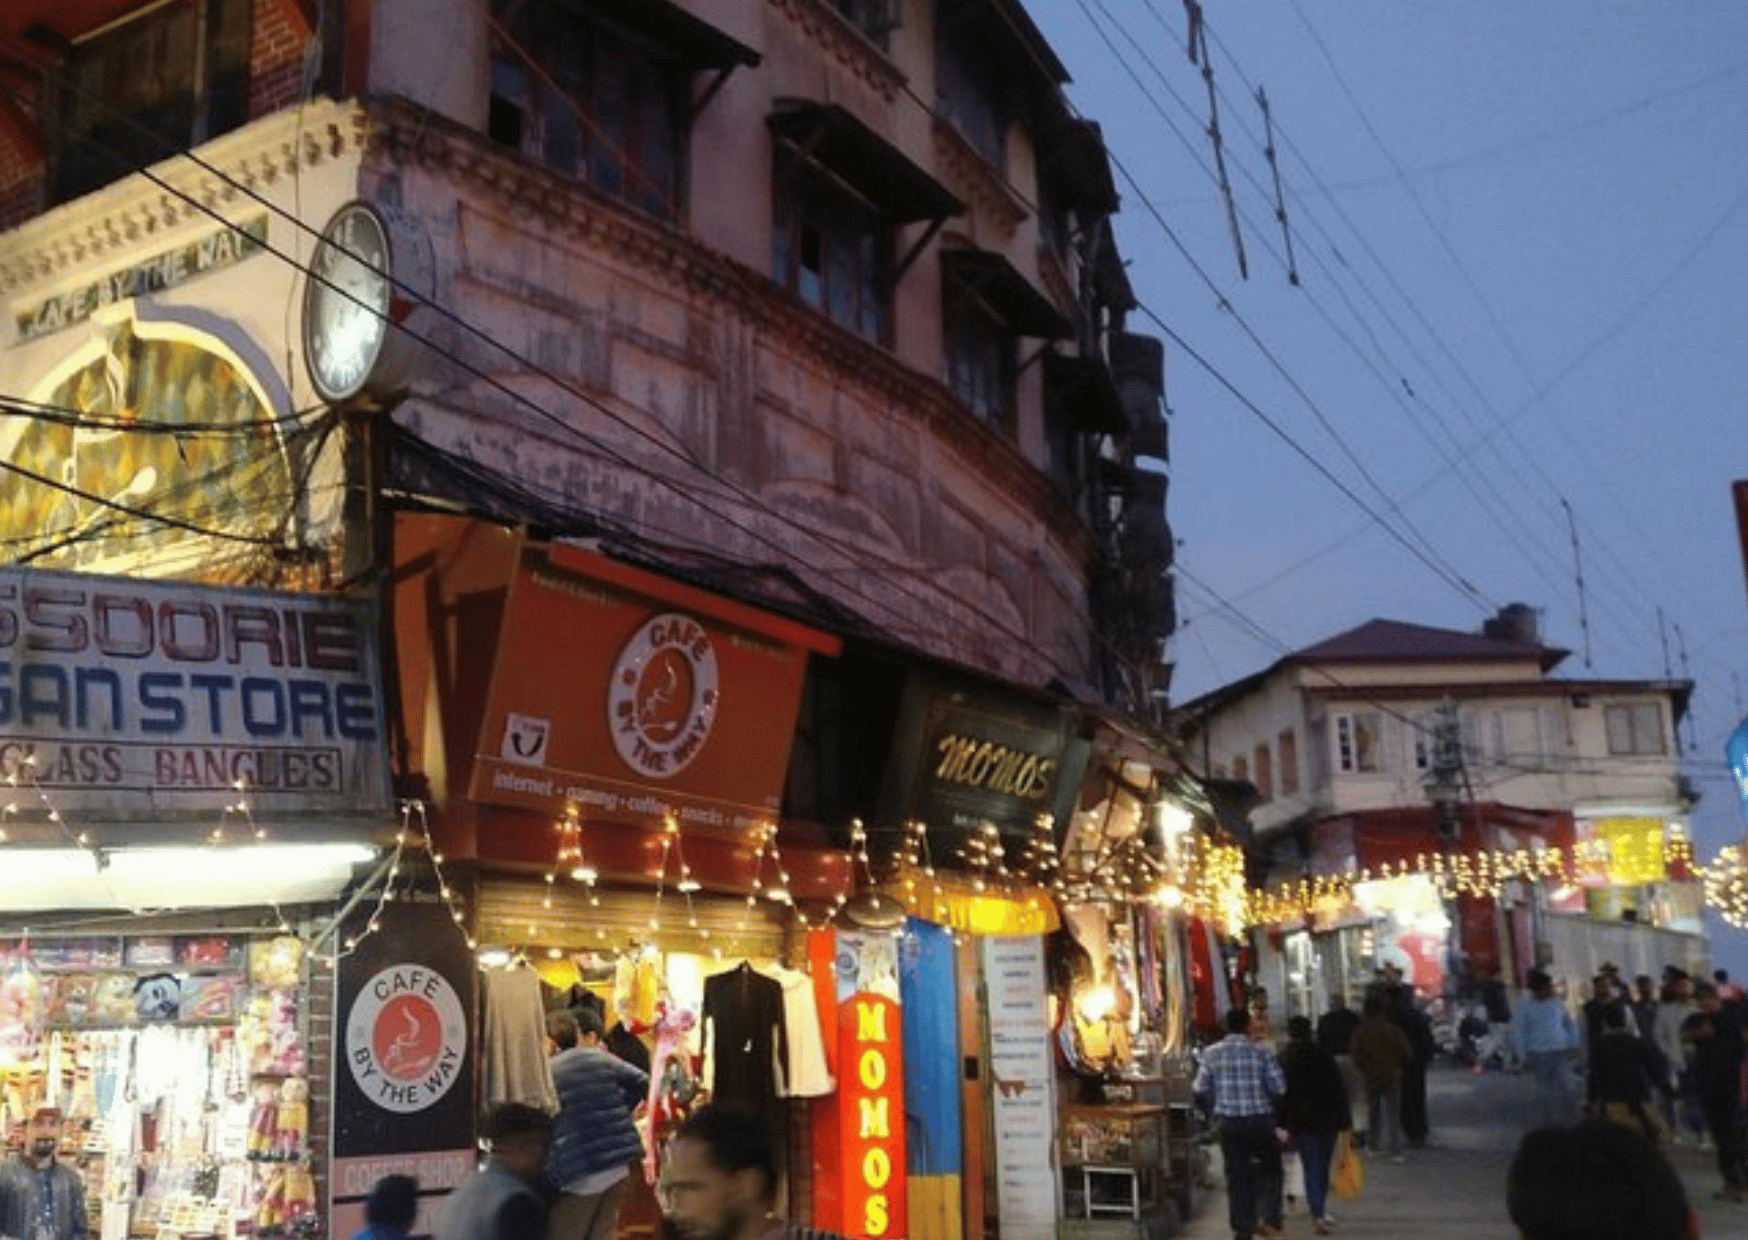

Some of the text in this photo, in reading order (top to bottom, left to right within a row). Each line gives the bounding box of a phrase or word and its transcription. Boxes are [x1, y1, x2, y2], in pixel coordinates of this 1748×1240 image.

[141, 252, 187, 289] THE
[650, 618, 708, 661] CAFE
[138, 671, 378, 741] STORE
[632, 737, 667, 772] THE
[673, 716, 706, 765] WAY
[374, 971, 440, 1001] CAFE
[353, 1047, 458, 1104] BY THE WAY
[856, 1001, 890, 1236] MOMOS
